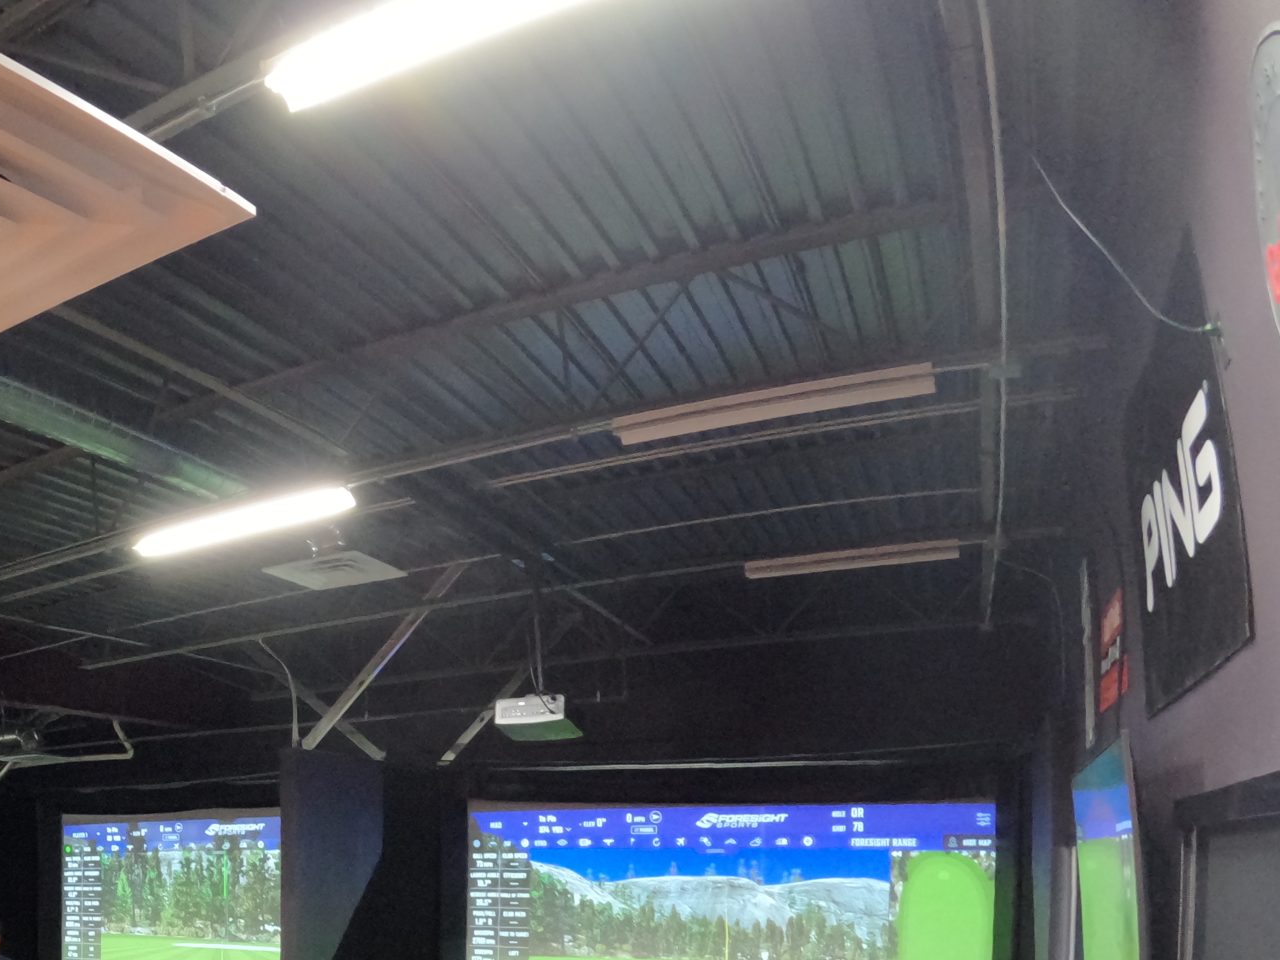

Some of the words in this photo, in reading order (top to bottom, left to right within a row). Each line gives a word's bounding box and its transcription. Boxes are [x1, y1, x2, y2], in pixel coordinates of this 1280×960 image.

[1140, 388, 1222, 613] PING
[717, 813, 789, 823] FORESIGHT
[716, 821, 759, 829] SPORTS
[850, 837, 890, 847] FORESIGHT
[892, 837, 918, 847] RANGE
